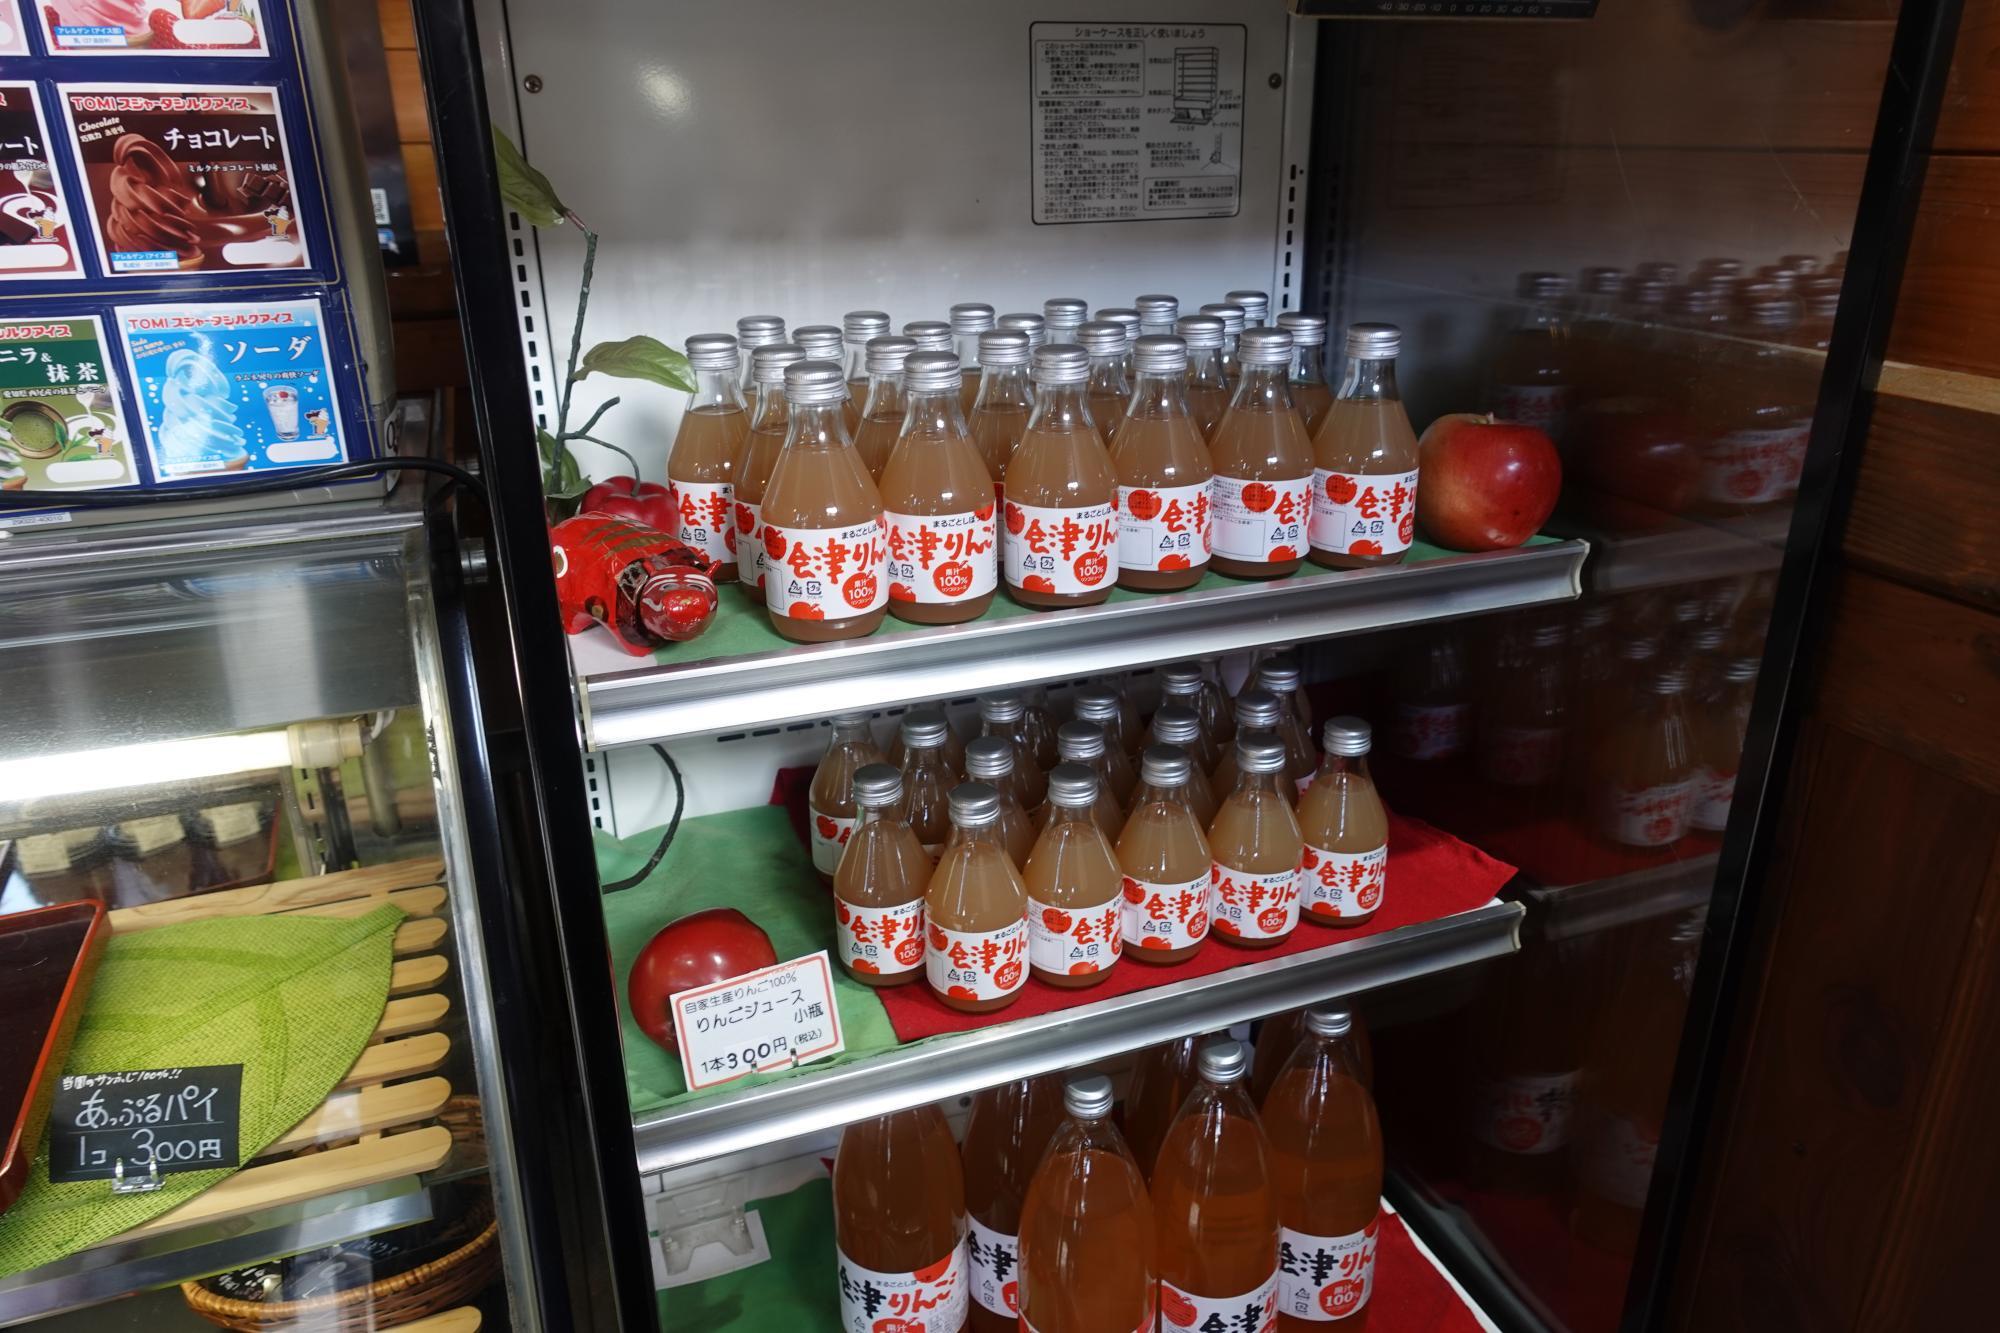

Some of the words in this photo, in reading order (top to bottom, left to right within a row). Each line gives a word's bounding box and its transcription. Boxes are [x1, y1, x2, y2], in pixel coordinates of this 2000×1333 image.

[71, 97, 116, 111] TOMI
[79, 117, 121, 132] Chocolate
[163, 127, 276, 151] チョコレート
[128, 318, 169, 329] TOMI
[223, 335, 313, 364] ソーダ
[46, 362, 100, 383] 抹茶
[680, 492, 732, 533] 会津
[939, 576, 968, 587] 100%
[1079, 566, 1104, 577] 100%
[848, 587, 874, 600] 100%
[685, 970, 798, 1014] 自家生産りんご100%
[696, 988, 805, 1033] りんごジュース
[794, 1001, 825, 1024] 小瓶
[75, 1085, 219, 1129] あっぷるパイ
[130, 1128, 222, 1166] 300円
[967, 1230, 1018, 1282] 会津
